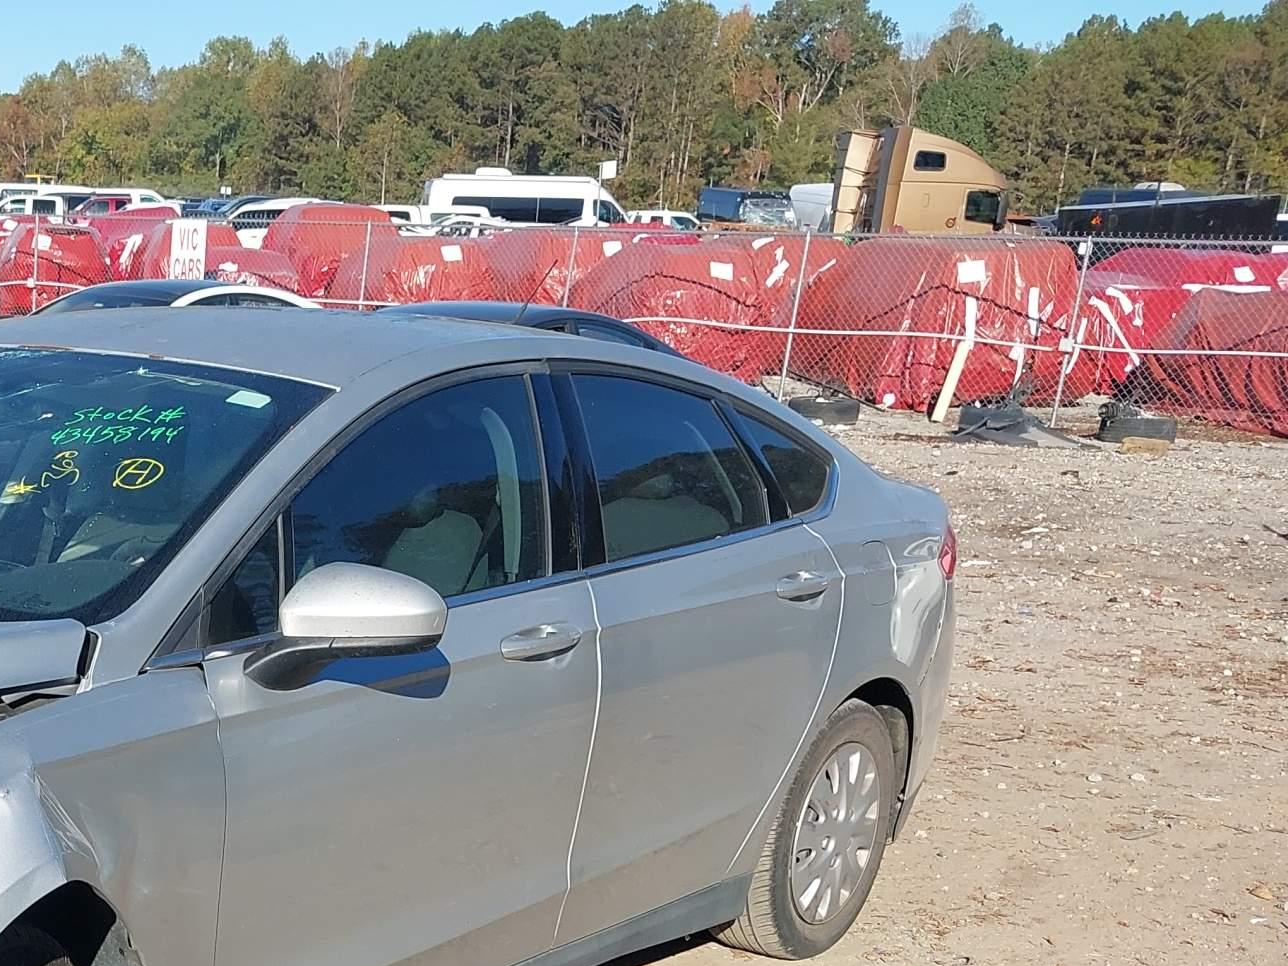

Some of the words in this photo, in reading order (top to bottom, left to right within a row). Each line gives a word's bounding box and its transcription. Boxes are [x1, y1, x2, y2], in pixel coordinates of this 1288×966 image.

[179, 227, 199, 250] VIC
[173, 258, 202, 280] CARS
[154, 406, 186, 424] #
[50, 425, 185, 445] 43458194
